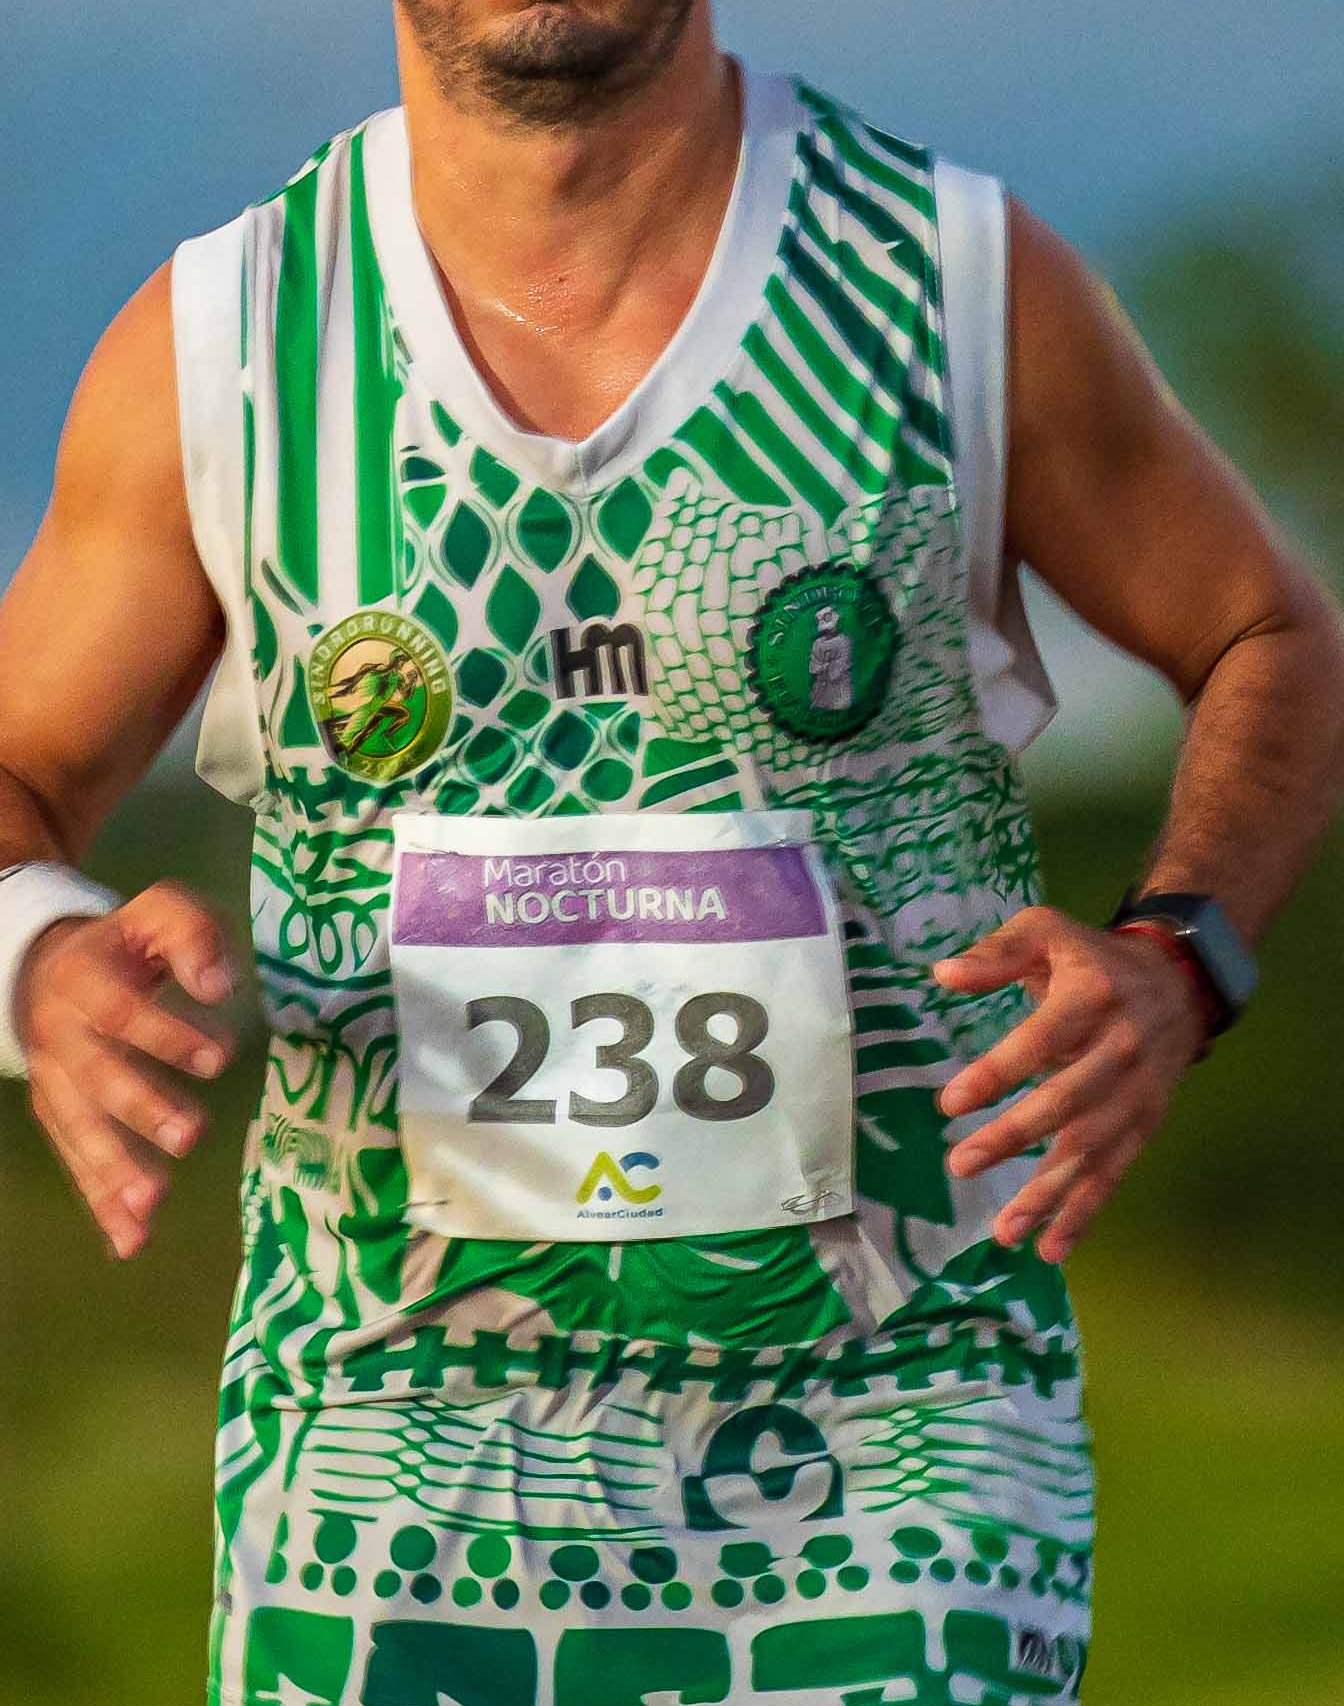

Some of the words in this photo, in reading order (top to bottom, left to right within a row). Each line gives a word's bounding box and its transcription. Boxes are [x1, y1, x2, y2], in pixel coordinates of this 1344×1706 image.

[483, 852, 626, 887] Maratón
[485, 886, 727, 925] NOCTURNA
[466, 991, 776, 1128] 238
[576, 1207, 664, 1219] AlvearCiudad
